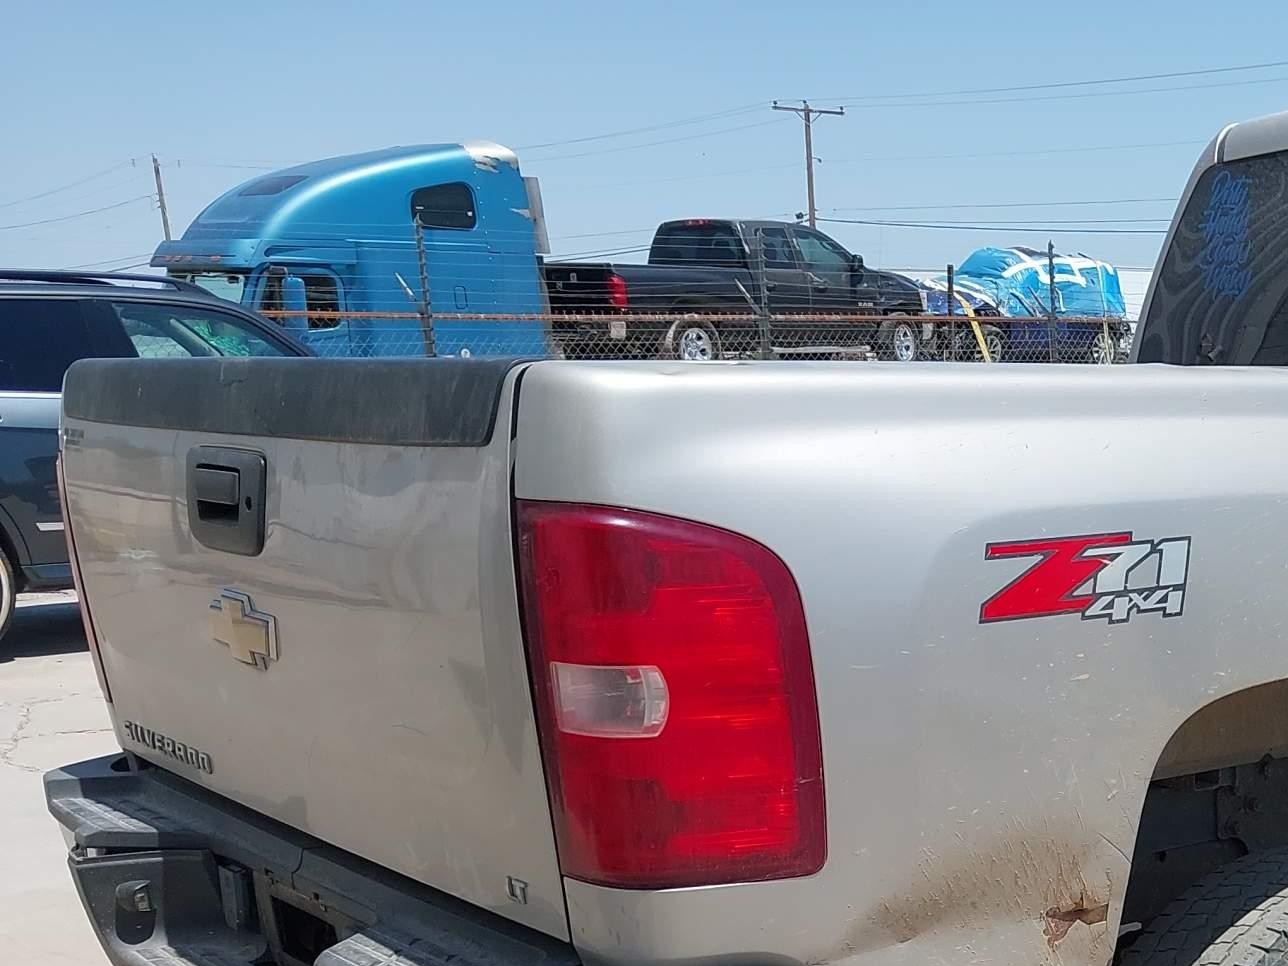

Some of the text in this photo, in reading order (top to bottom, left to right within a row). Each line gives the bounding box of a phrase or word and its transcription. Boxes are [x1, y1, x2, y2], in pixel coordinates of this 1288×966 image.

[979, 531, 1192, 624] Z71
[124, 720, 213, 775] SILVERADO
[506, 875, 529, 905] LT
